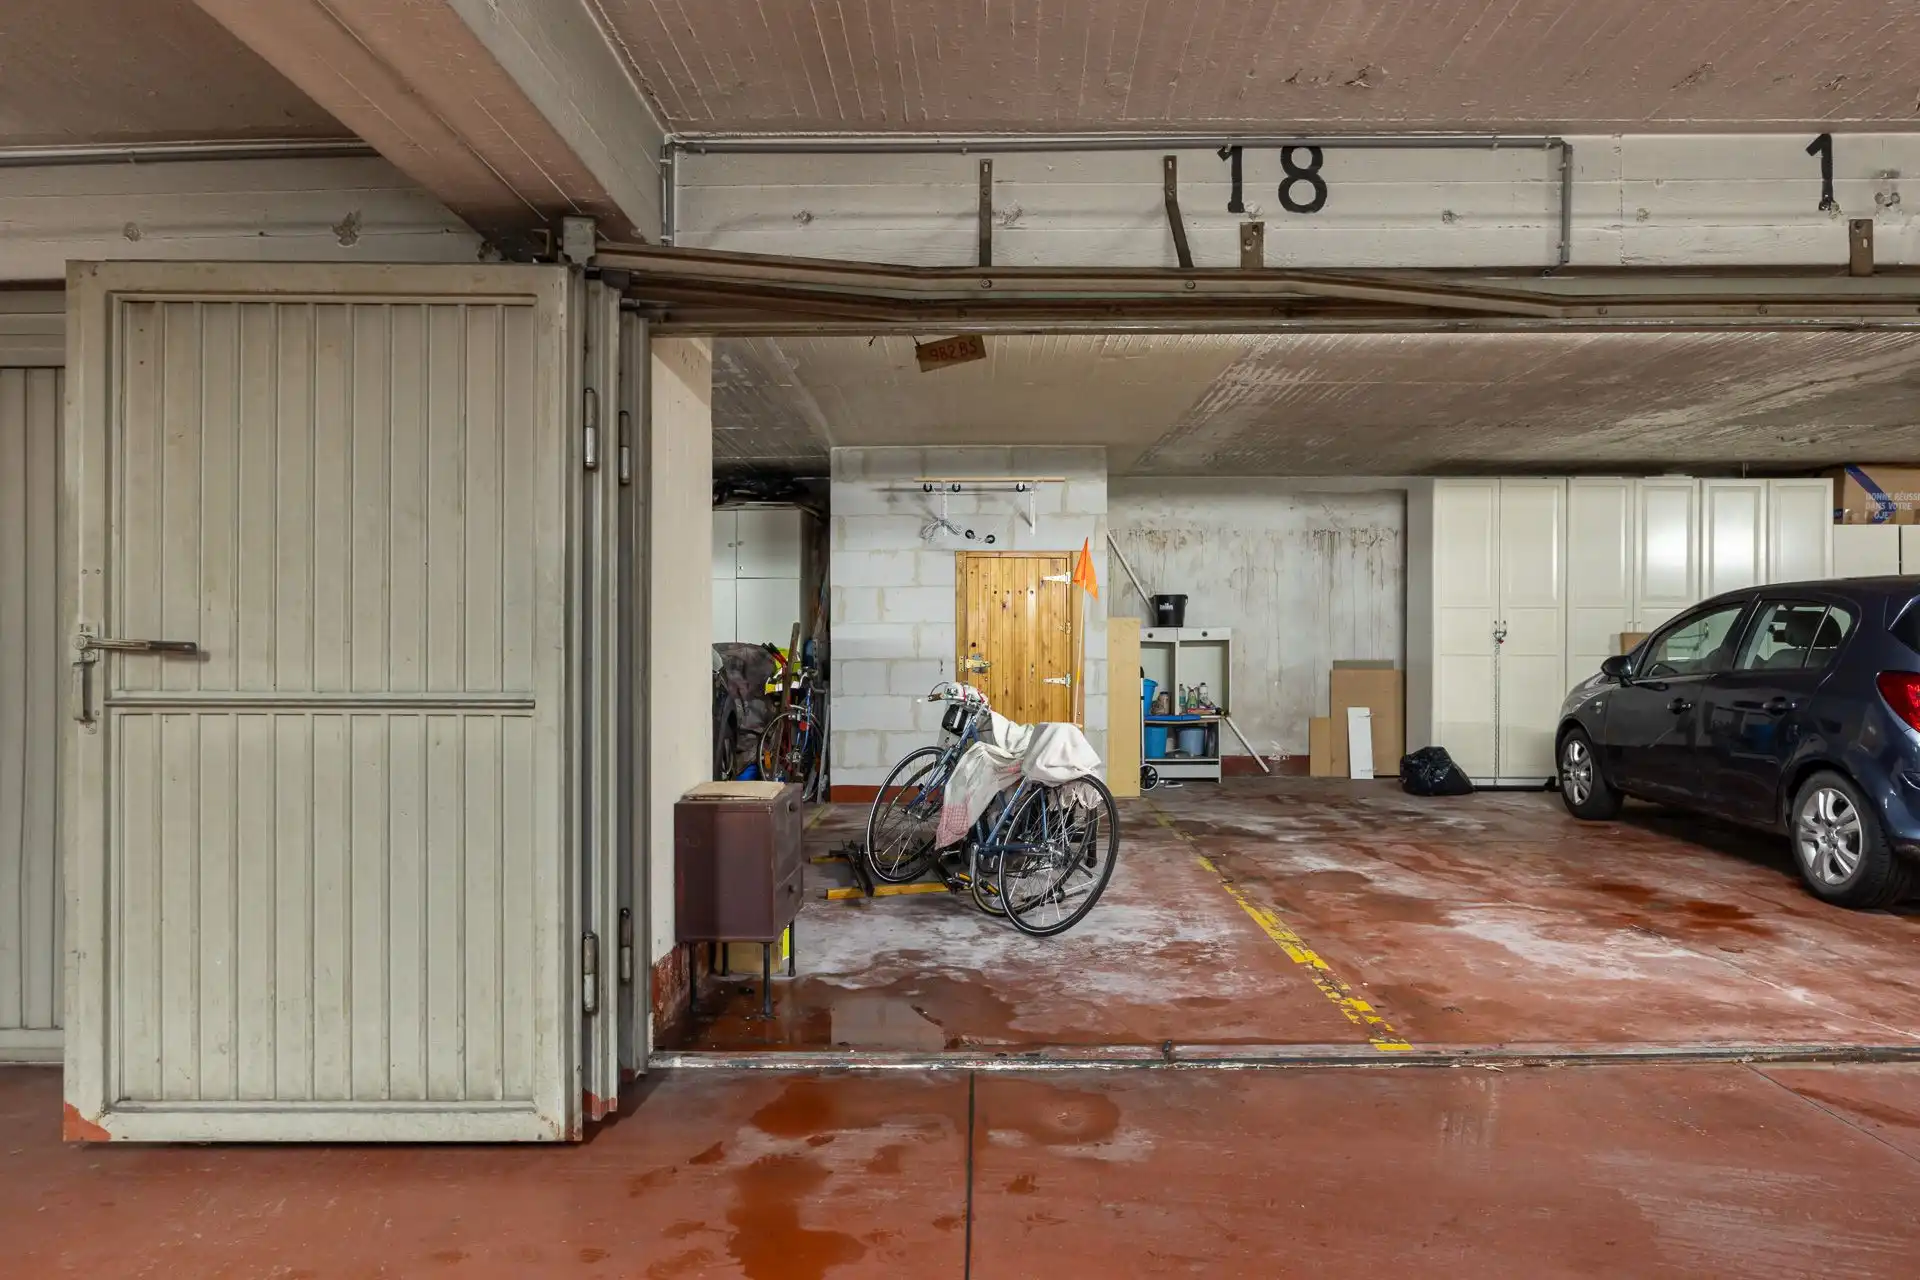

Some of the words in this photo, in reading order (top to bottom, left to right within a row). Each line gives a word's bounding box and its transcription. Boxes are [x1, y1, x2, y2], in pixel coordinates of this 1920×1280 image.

[1217, 145, 1328, 213] 18
[1805, 133, 1834, 211] 1
[1865, 502, 1886, 510] DANS
[1888, 502, 1913, 511] VOTRE
